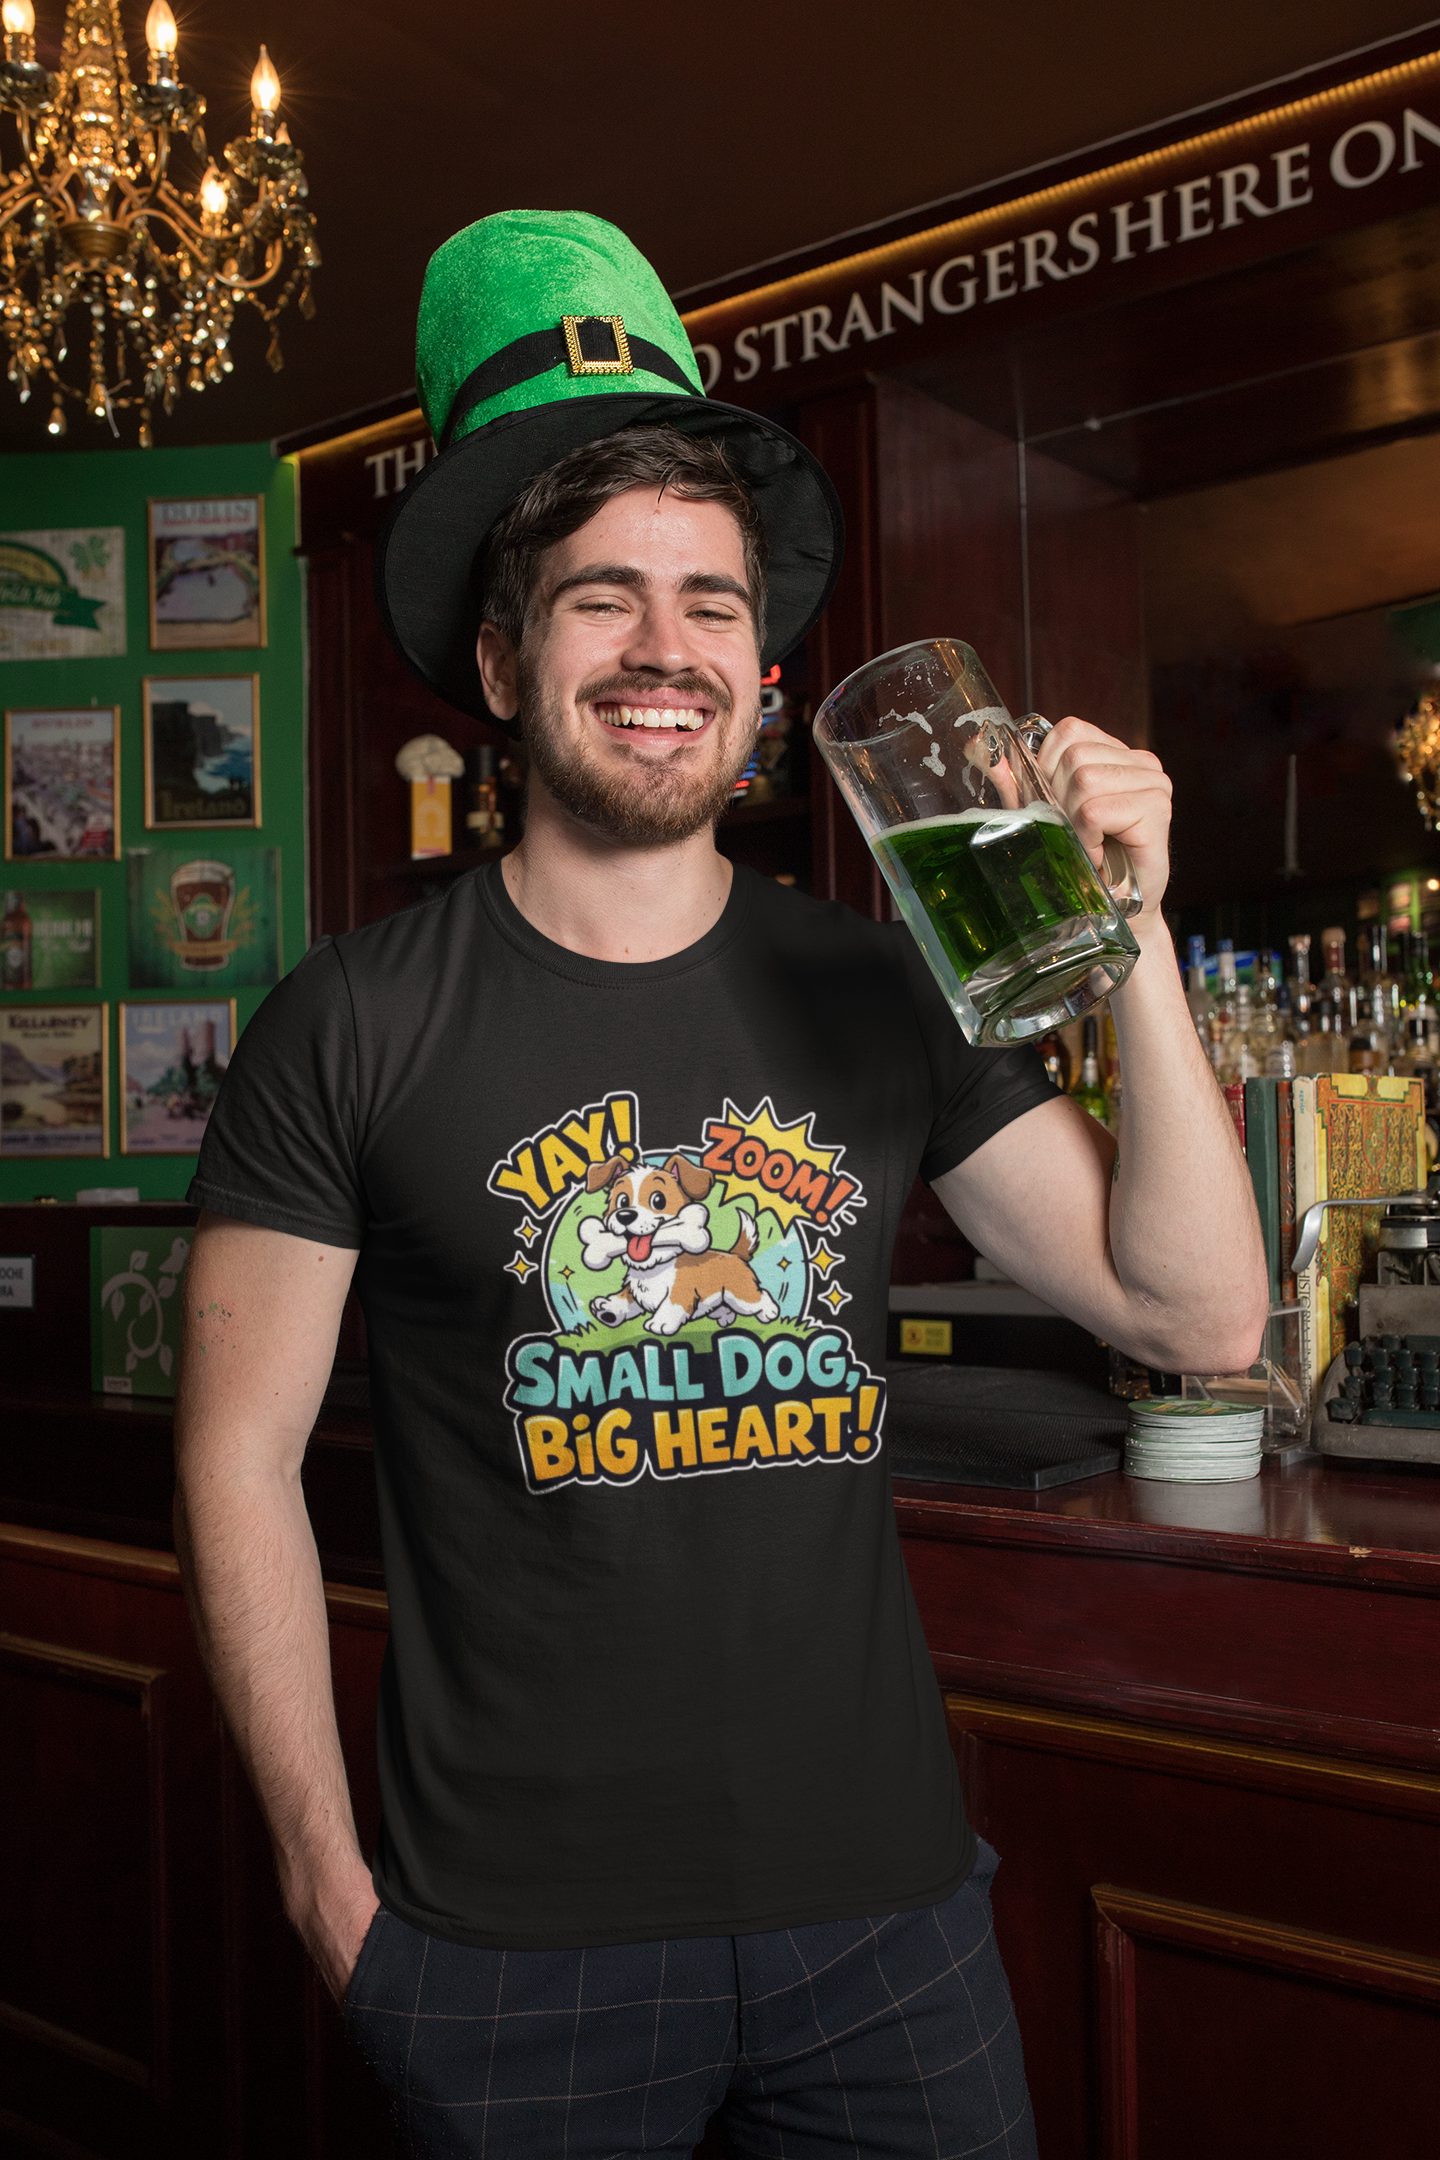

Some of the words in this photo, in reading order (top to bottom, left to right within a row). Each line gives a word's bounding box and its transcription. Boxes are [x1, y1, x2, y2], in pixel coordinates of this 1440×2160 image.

[364, 436, 438, 499] TH
[732, 213, 1100, 384] STRANGERS
[1110, 142, 1314, 263] HERE
[495, 1098, 637, 1210] YAY!
[702, 1124, 858, 1225] ZOOM!
[512, 1340, 705, 1410] SMALL
[716, 1334, 860, 1393] DOG,
[652, 1384, 880, 1471] HEART!
